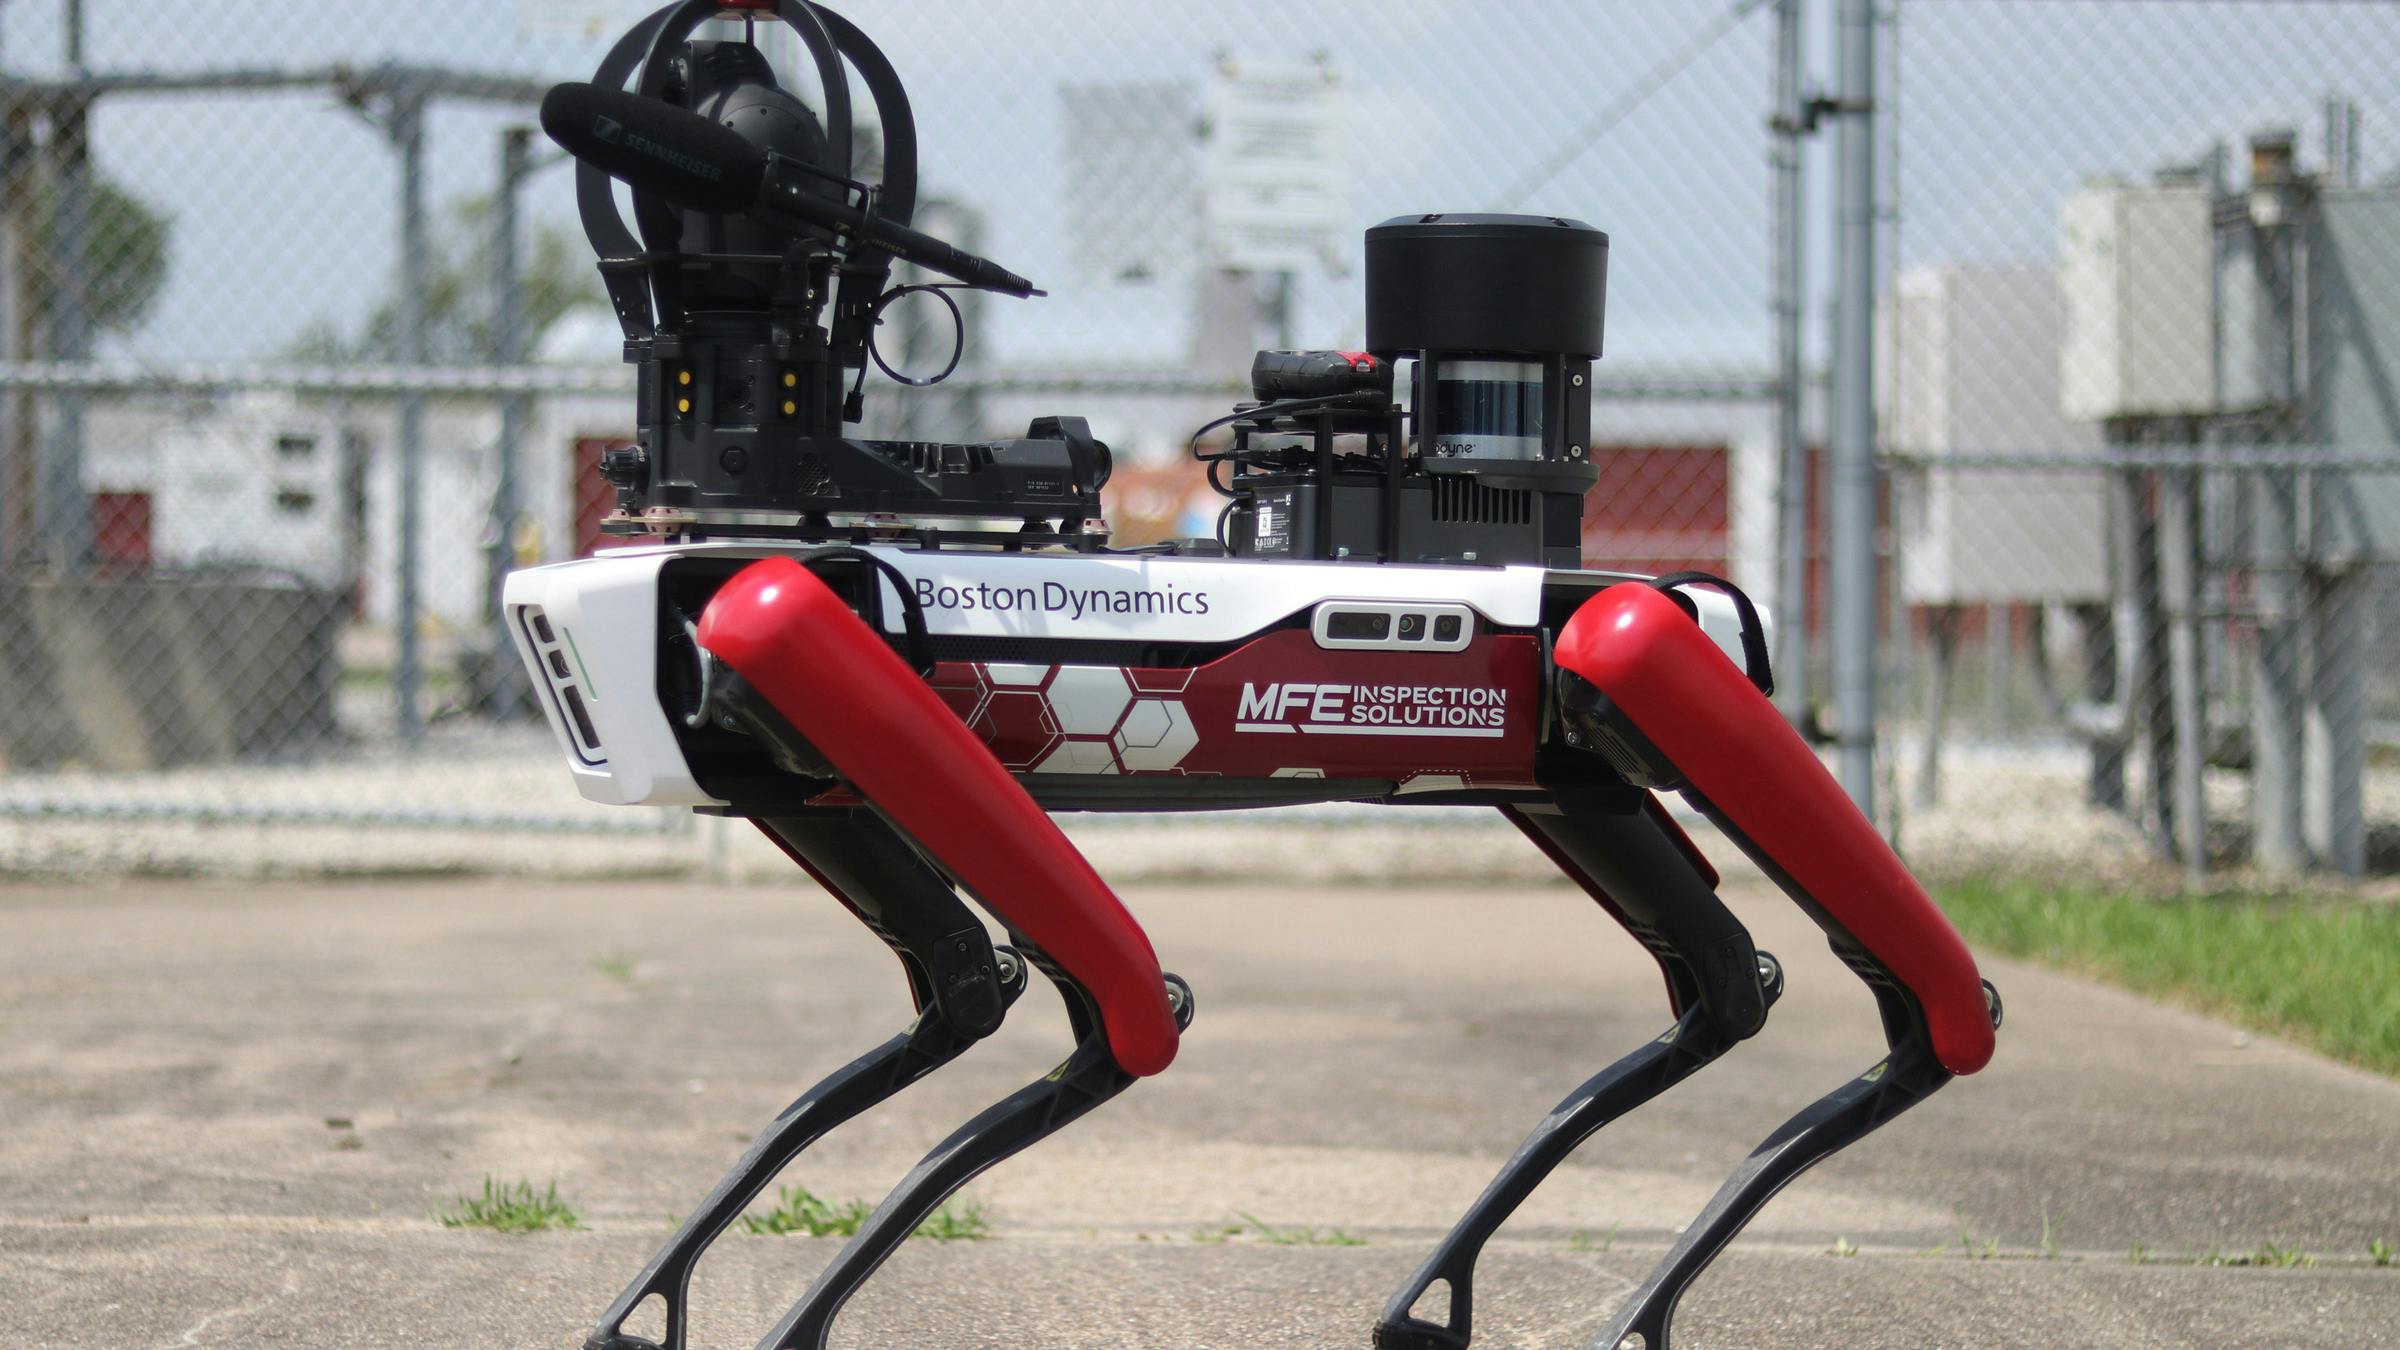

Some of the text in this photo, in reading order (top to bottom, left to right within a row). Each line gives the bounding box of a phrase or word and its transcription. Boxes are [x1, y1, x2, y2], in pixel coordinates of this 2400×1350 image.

[624, 133, 722, 182] SENNHEISER
[1434, 440, 1474, 457] odyne
[915, 578, 1210, 620] Boston Dynamics
[1237, 682, 1507, 722] MFE INSPECTION
[1350, 704, 1505, 727] SOLUTIONS
